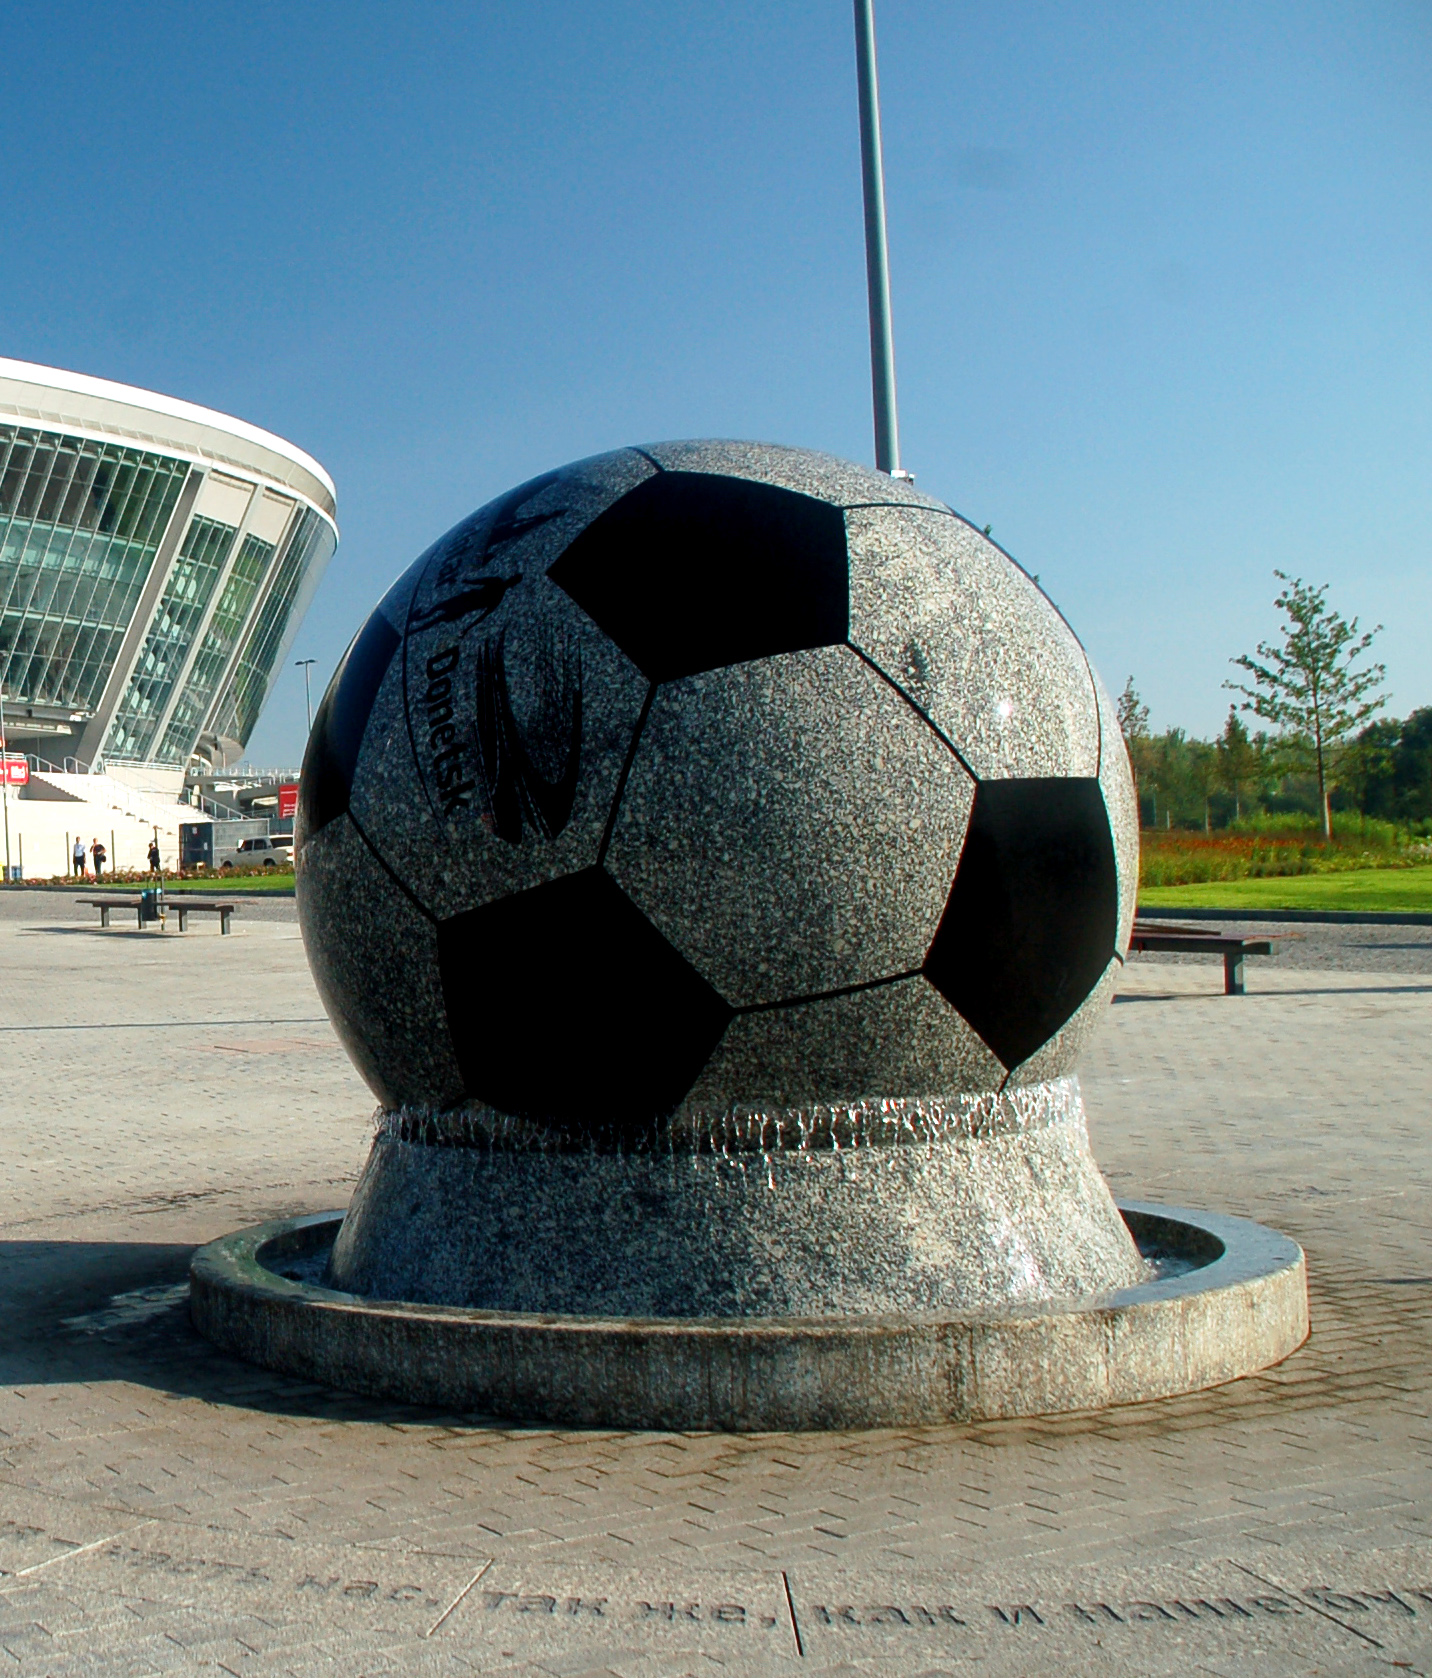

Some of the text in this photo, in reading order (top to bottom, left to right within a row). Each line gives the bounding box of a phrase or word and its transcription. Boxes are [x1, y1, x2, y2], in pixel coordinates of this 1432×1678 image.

[426, 645, 476, 818] Donetsk
[480, 1588, 607, 1619] так
[634, 1600, 777, 1630] же,
[812, 1605, 966, 1626] как
[984, 1605, 1044, 1626] и
